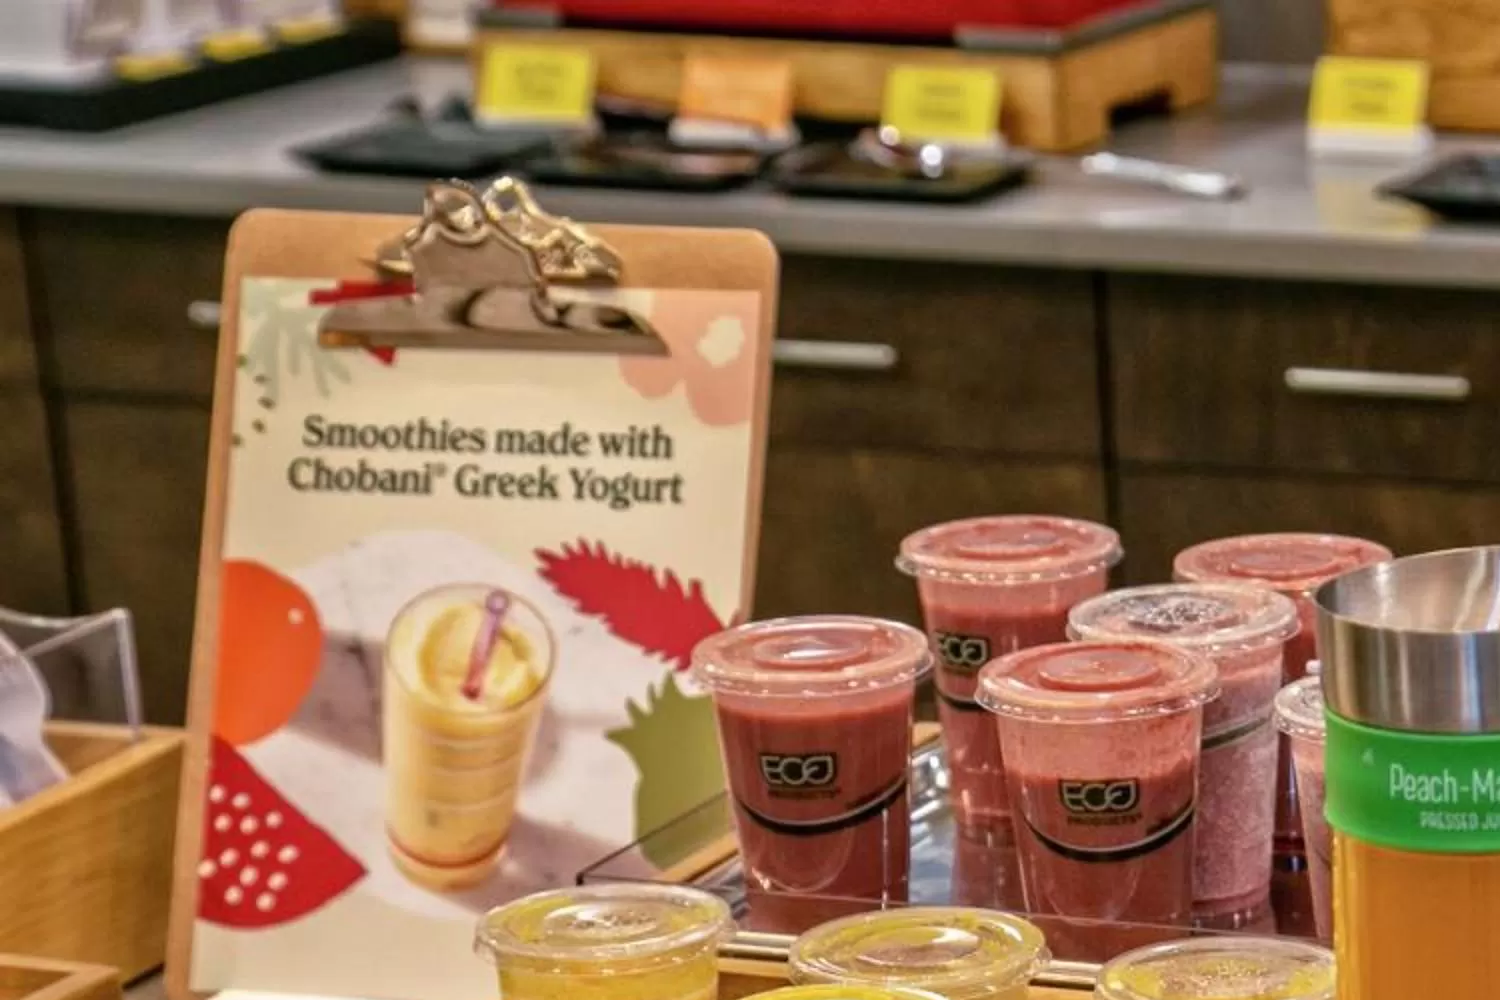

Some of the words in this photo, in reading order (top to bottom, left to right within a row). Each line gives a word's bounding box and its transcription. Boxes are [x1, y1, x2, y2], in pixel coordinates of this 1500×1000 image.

[302, 413, 486, 454] Smoothies
[495, 422, 590, 457] made
[598, 424, 673, 460] with
[454, 464, 560, 500] Greek
[569, 467, 684, 510] Yogurt
